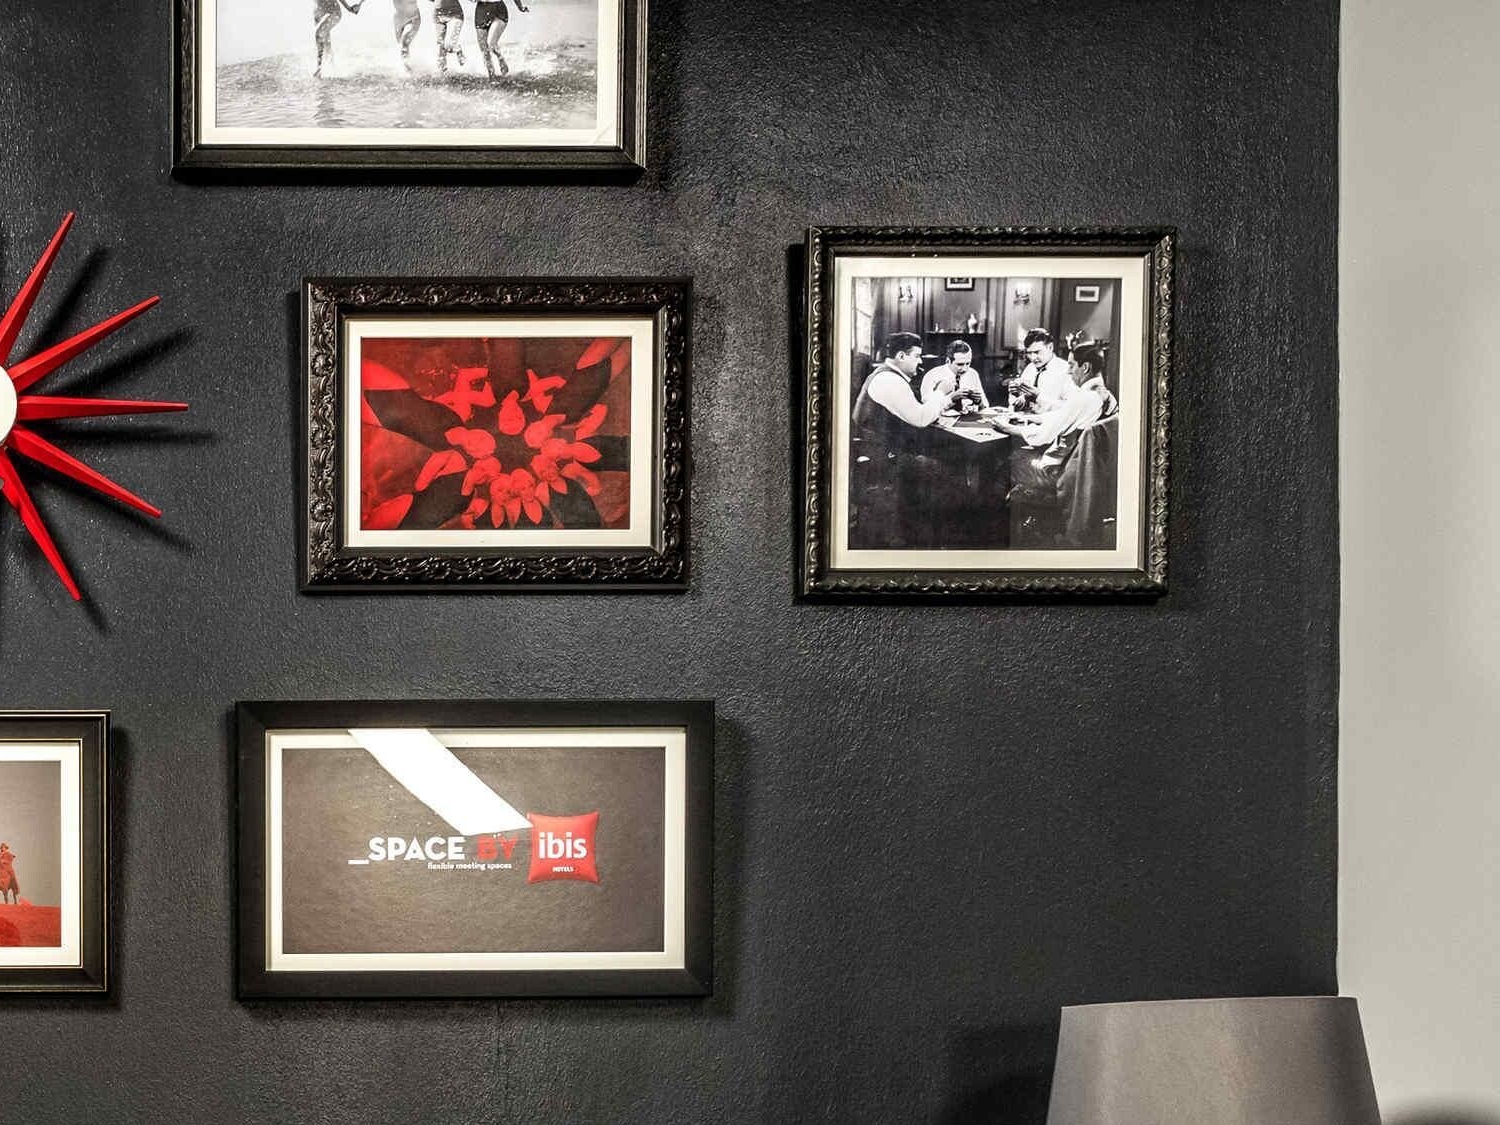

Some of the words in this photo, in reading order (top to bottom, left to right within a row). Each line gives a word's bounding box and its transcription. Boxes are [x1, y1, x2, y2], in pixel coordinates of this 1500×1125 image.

[477, 834, 518, 861] BY
[538, 831, 588, 860] ibis
[455, 862, 486, 871] meeting
[487, 863, 512, 871] spaces
